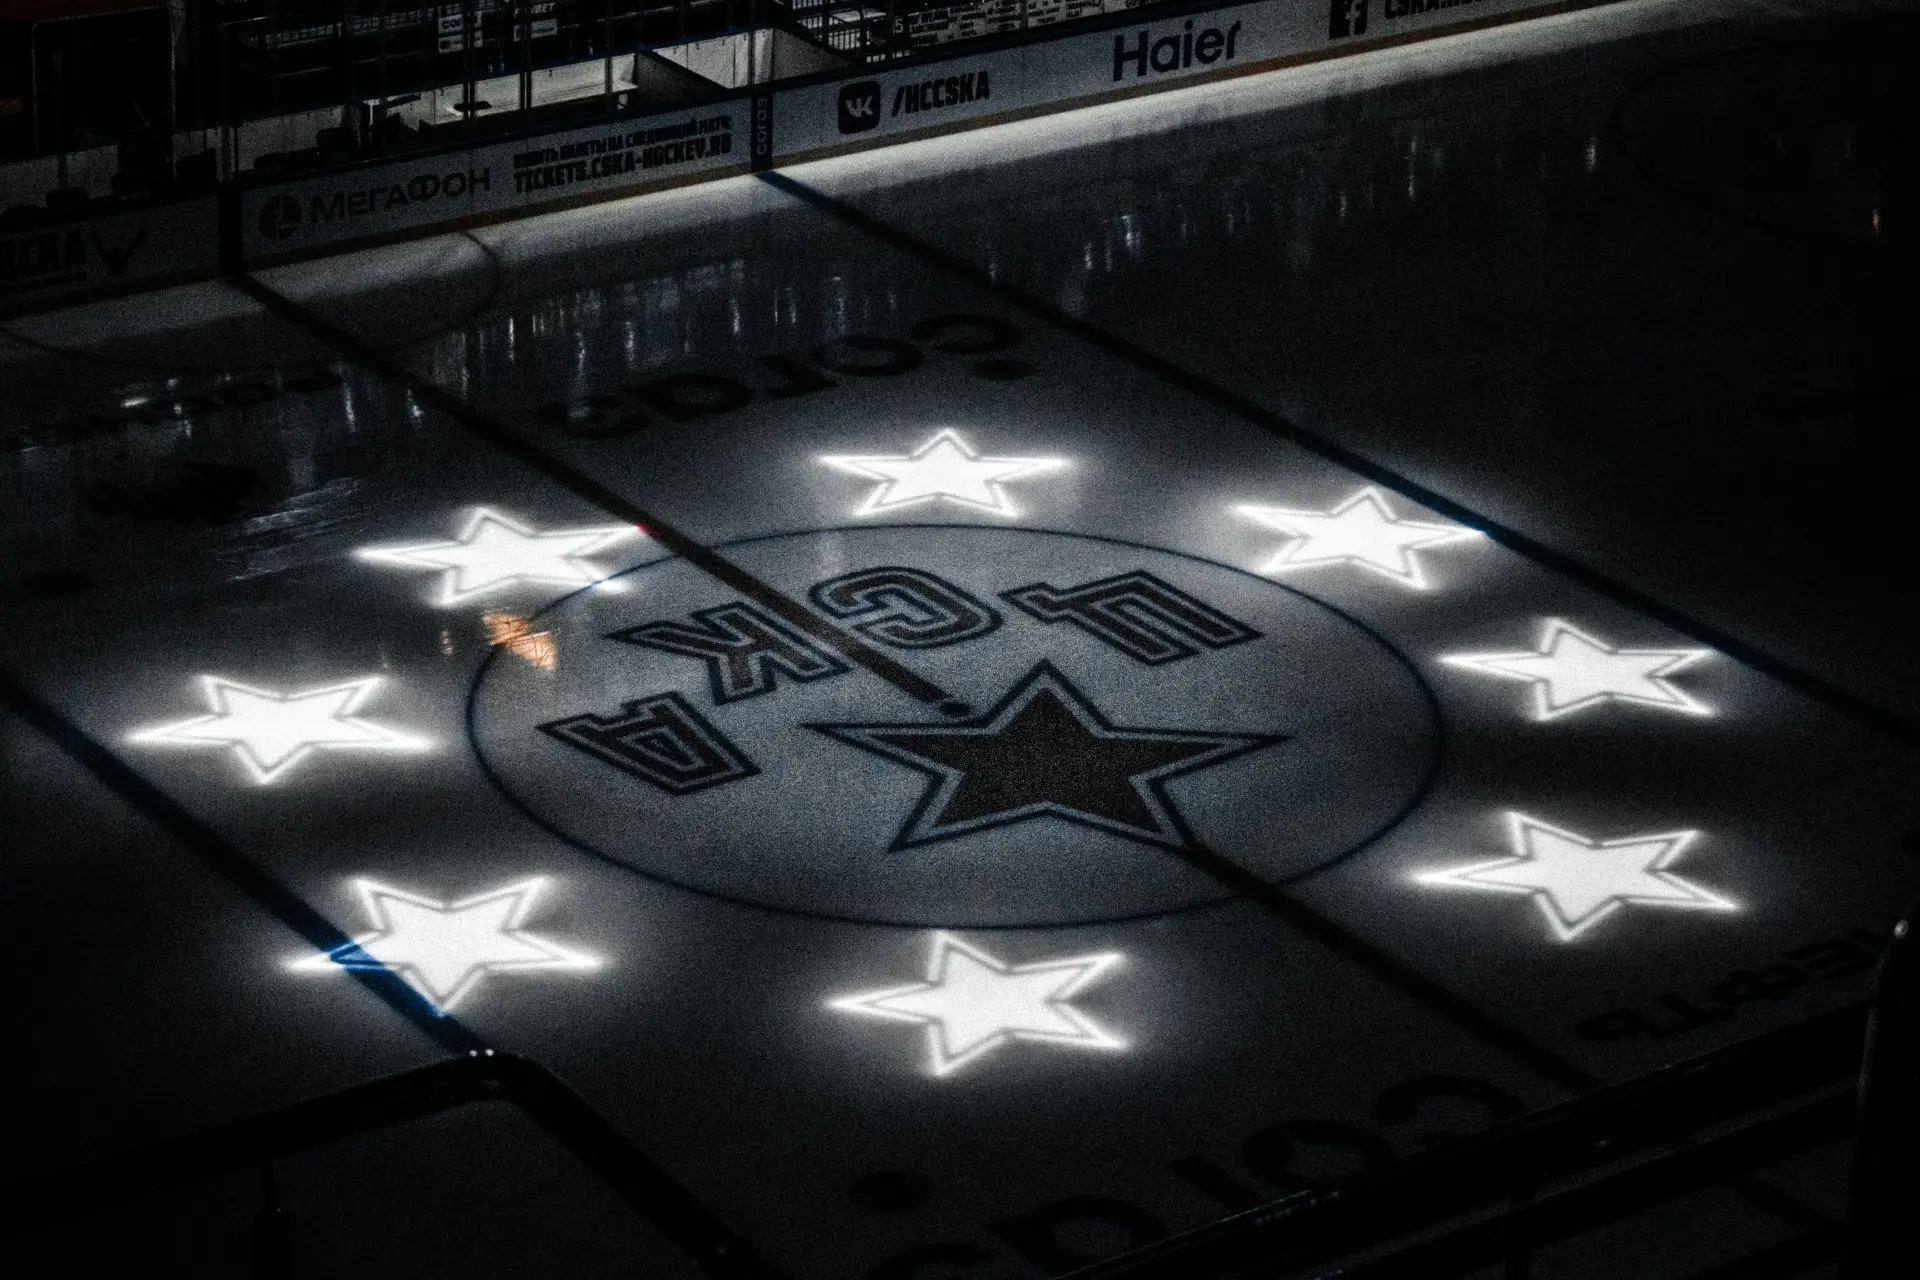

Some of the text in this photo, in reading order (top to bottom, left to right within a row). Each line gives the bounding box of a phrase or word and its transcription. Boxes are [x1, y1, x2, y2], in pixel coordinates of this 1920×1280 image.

[1113, 20, 1243, 82] Haier
[891, 71, 990, 117] /HCCSKA
[310, 167, 490, 223] МЕГАФОН
